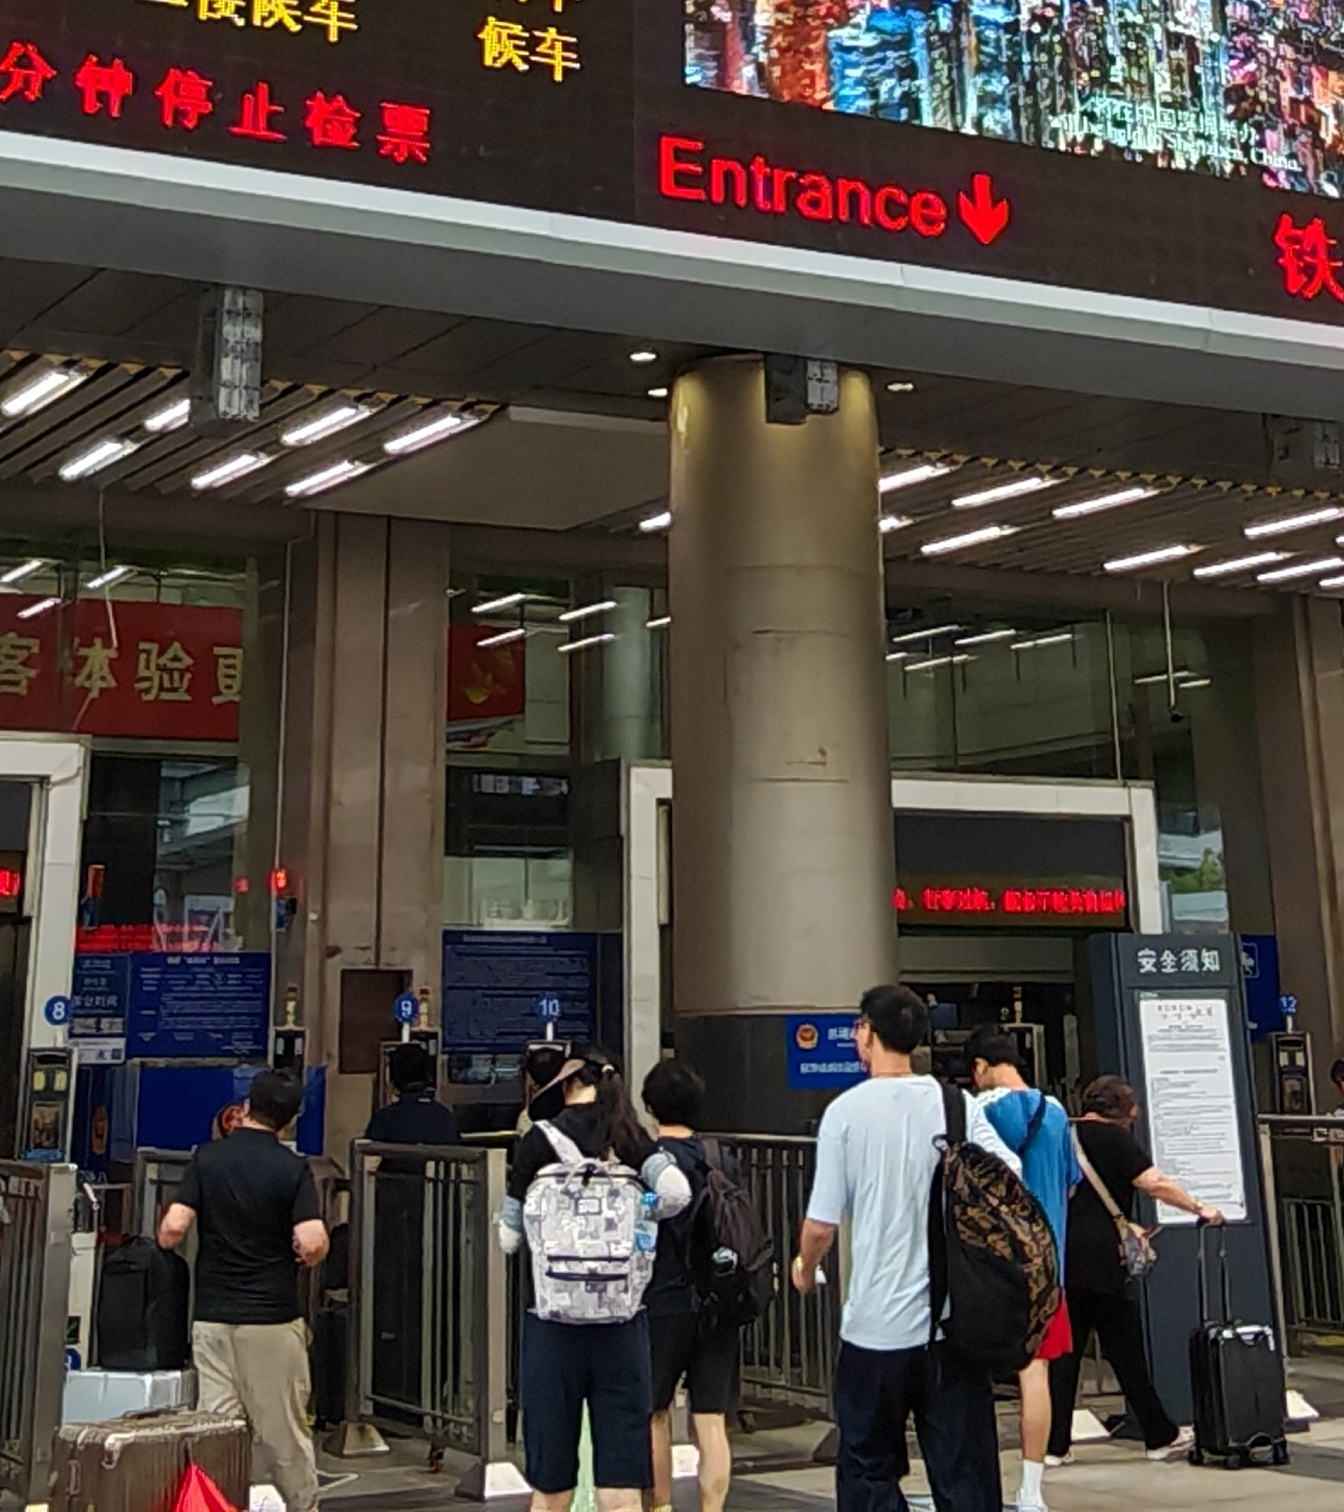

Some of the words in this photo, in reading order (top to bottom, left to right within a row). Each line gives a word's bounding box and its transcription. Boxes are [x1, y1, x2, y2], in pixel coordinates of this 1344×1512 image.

[479, 16, 581, 81] 候车
[659, 135, 947, 239] Entrance
[1137, 948, 1220, 973] 安全须知
[52, 1001, 65, 1021] 8
[400, 1000, 413, 1018] 9
[539, 999, 560, 1017] 10
[1280, 996, 1298, 1009] 12
